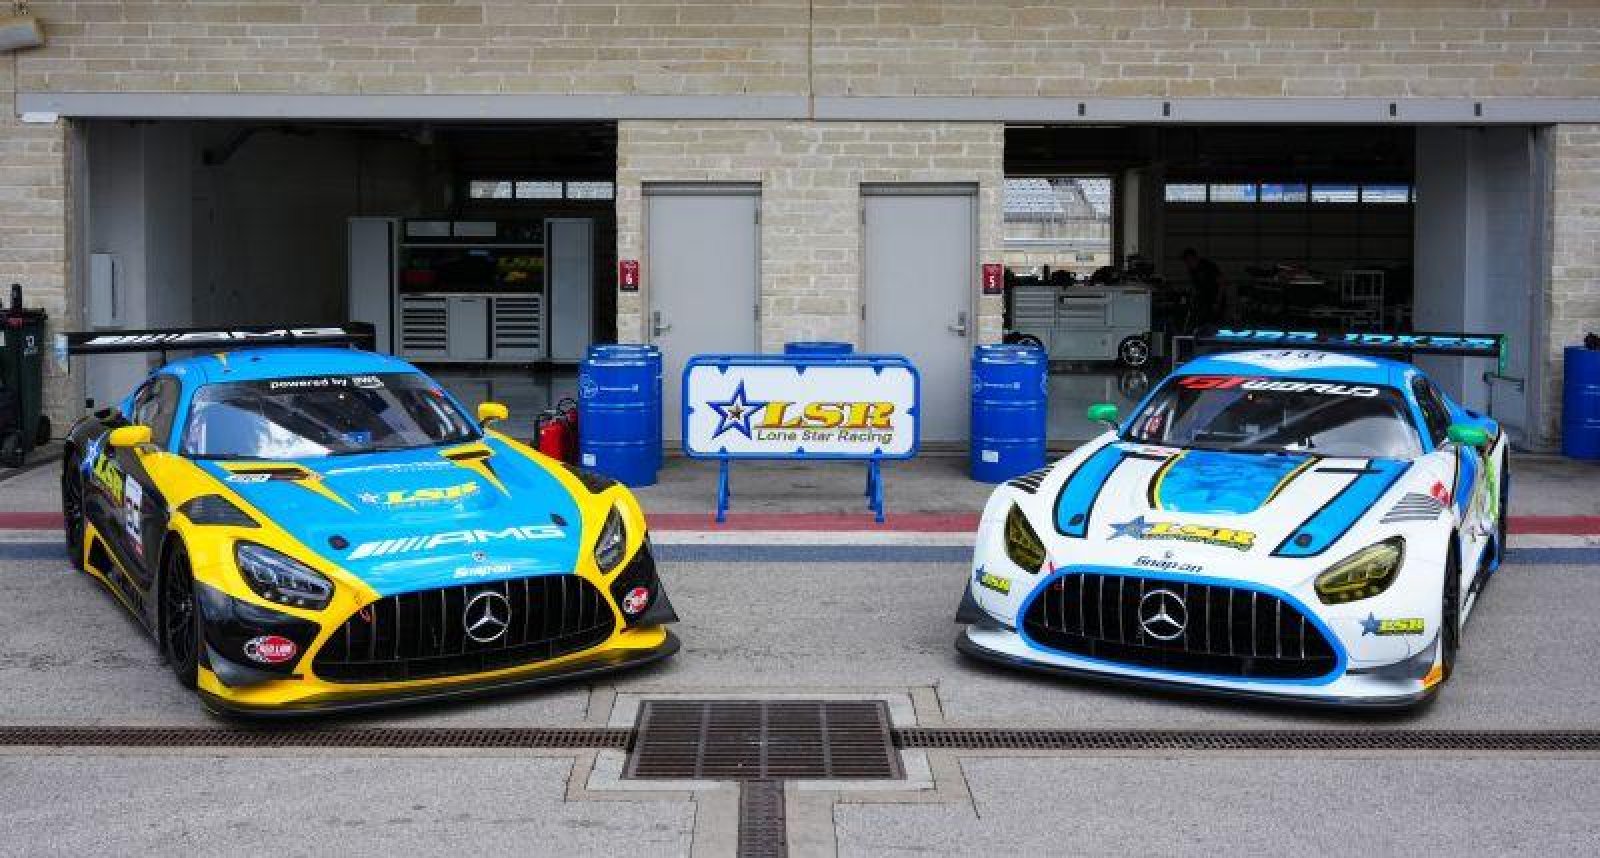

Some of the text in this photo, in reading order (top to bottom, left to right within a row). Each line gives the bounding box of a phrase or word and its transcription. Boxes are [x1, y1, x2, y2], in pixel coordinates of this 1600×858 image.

[270, 379, 329, 390] powered
[332, 377, 348, 387] by
[760, 400, 896, 429] LSR
[757, 430, 893, 444] Lone Star Racing
[384, 482, 480, 504] LSR
[426, 525, 567, 549] AMG
[1143, 521, 1257, 545] LSR
[1379, 618, 1425, 633] LSR
